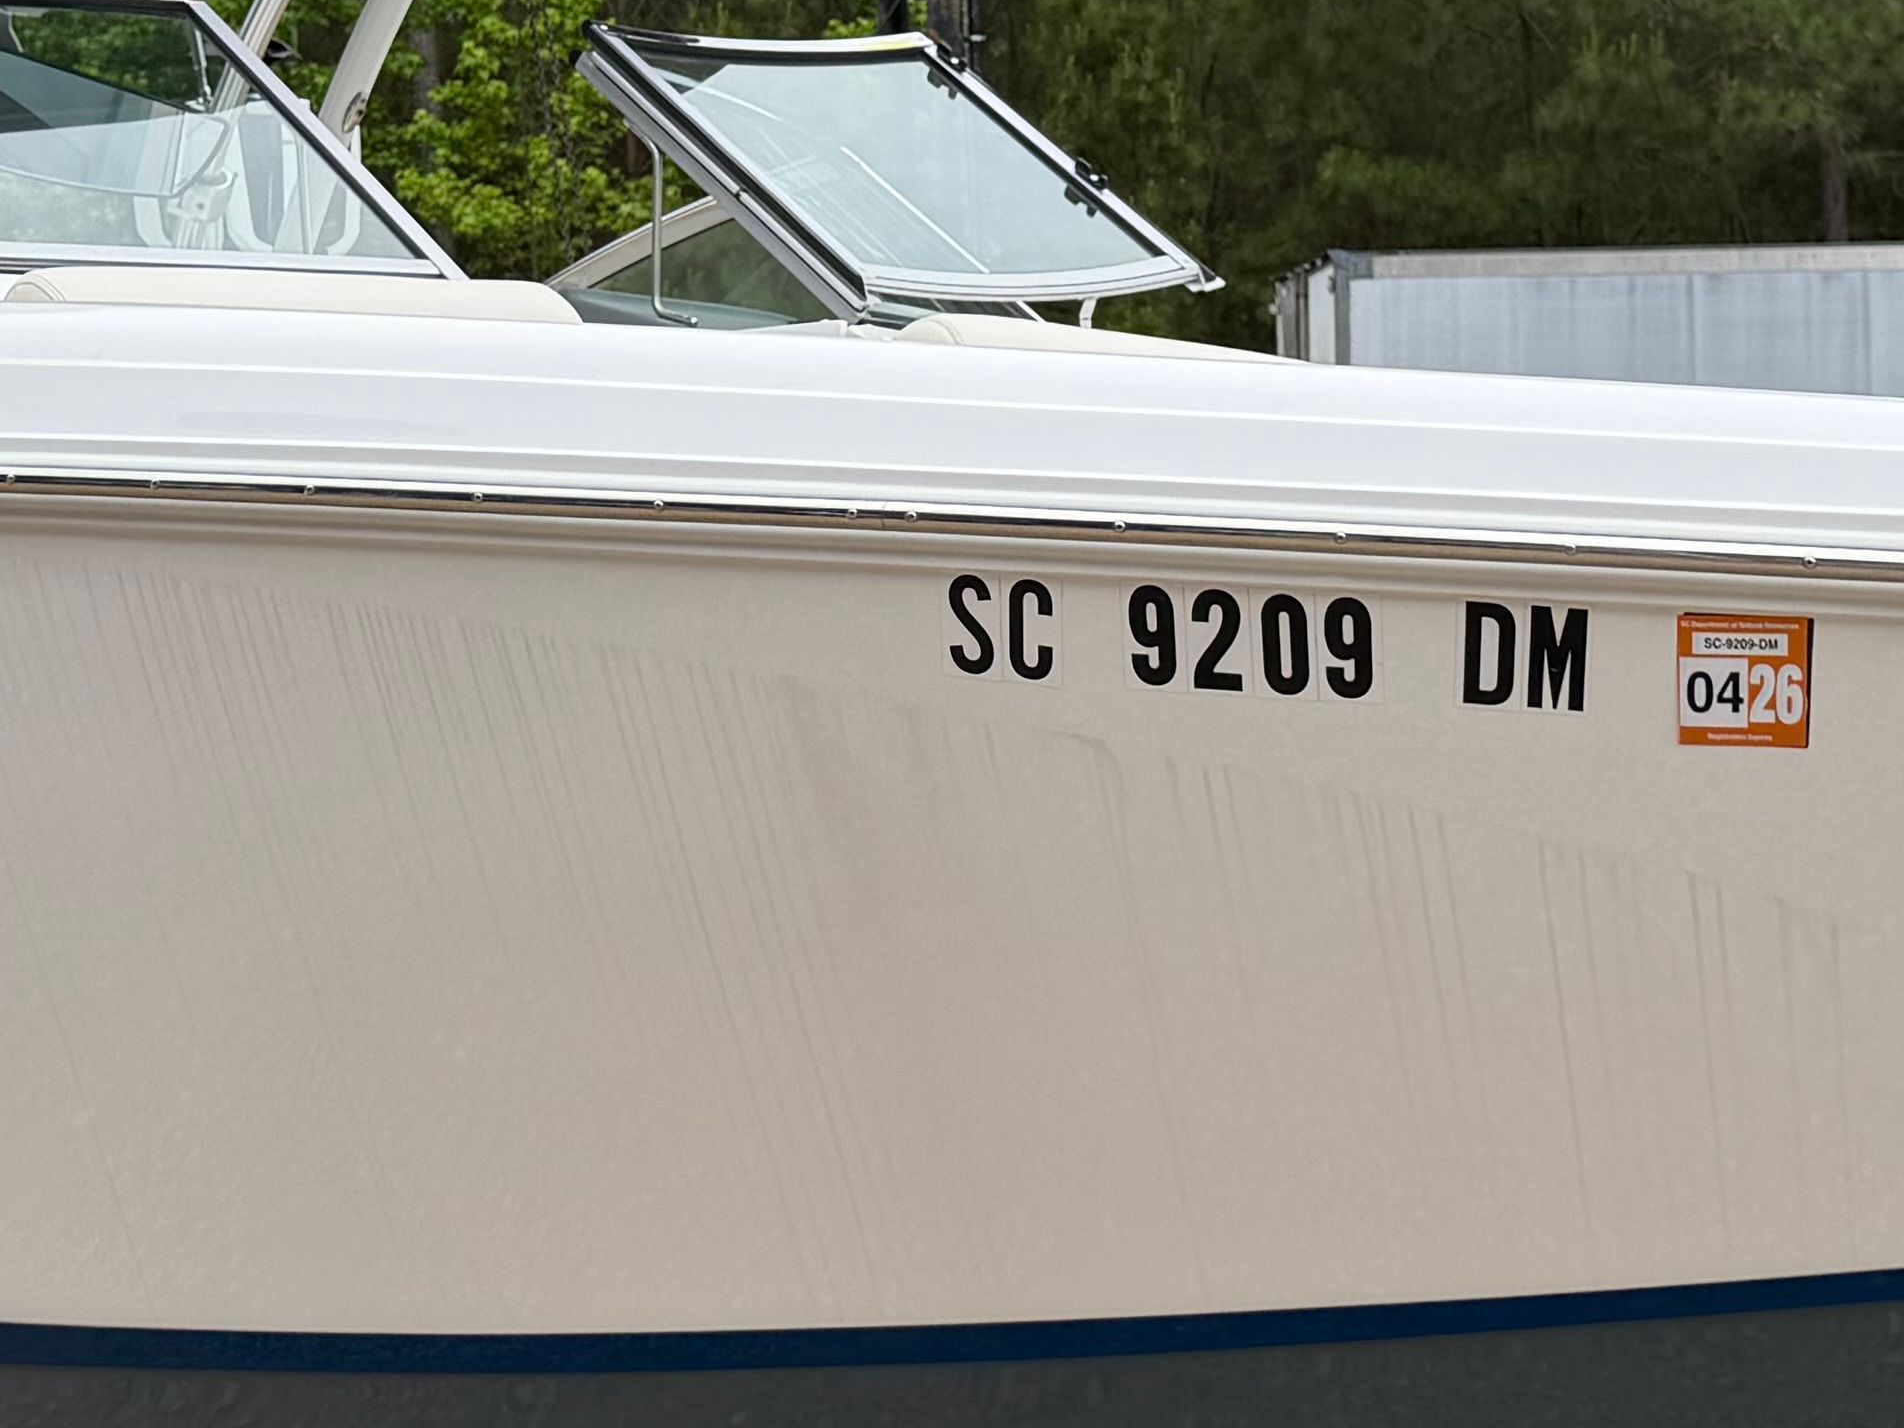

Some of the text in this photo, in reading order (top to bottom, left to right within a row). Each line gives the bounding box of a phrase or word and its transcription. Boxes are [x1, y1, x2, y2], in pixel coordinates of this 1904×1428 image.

[948, 574, 1588, 711] SC 9209 DM
[1704, 637, 1779, 650] SC-9209-DM
[1686, 663, 1804, 724] 04 26
